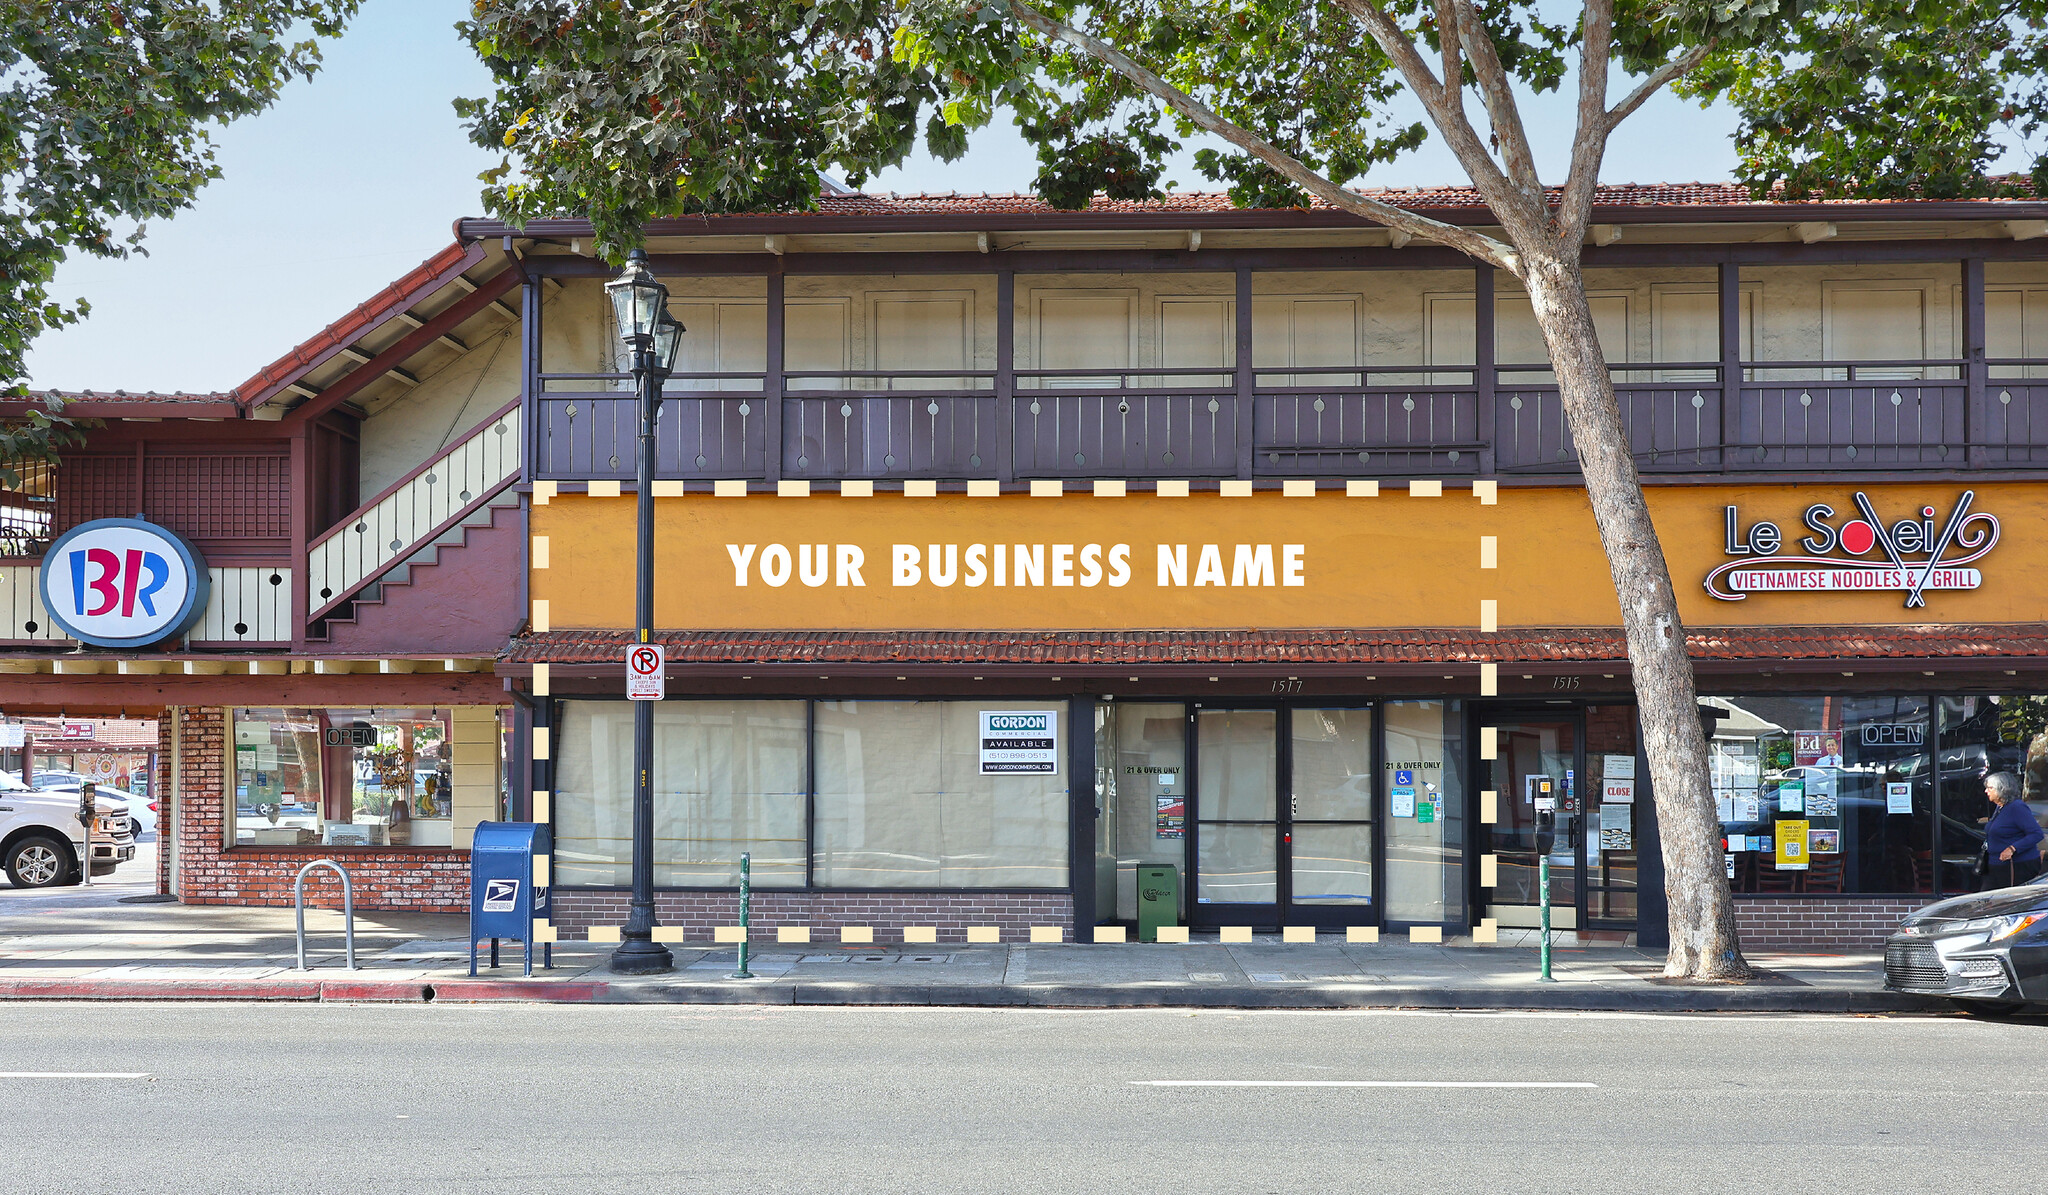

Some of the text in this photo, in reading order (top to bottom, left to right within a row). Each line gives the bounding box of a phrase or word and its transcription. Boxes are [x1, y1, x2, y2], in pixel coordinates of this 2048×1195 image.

[1724, 505, 1782, 556] Le
[69, 548, 170, 618] BR
[1734, 570, 1976, 588] VIETNAMESE NOODLES & GRILL
[1271, 680, 1304, 693] 1517
[1552, 676, 1580, 690] 1515
[991, 716, 1045, 729] GORDON
[327, 729, 375, 745] OPEN
[1865, 725, 1920, 743] OPEN
[1799, 736, 1820, 750] Ed
[1126, 766, 1180, 774] 21 & OVER ONLY
[1423, 761, 1441, 769] ONLY
[1607, 786, 1631, 797] CLOSE
